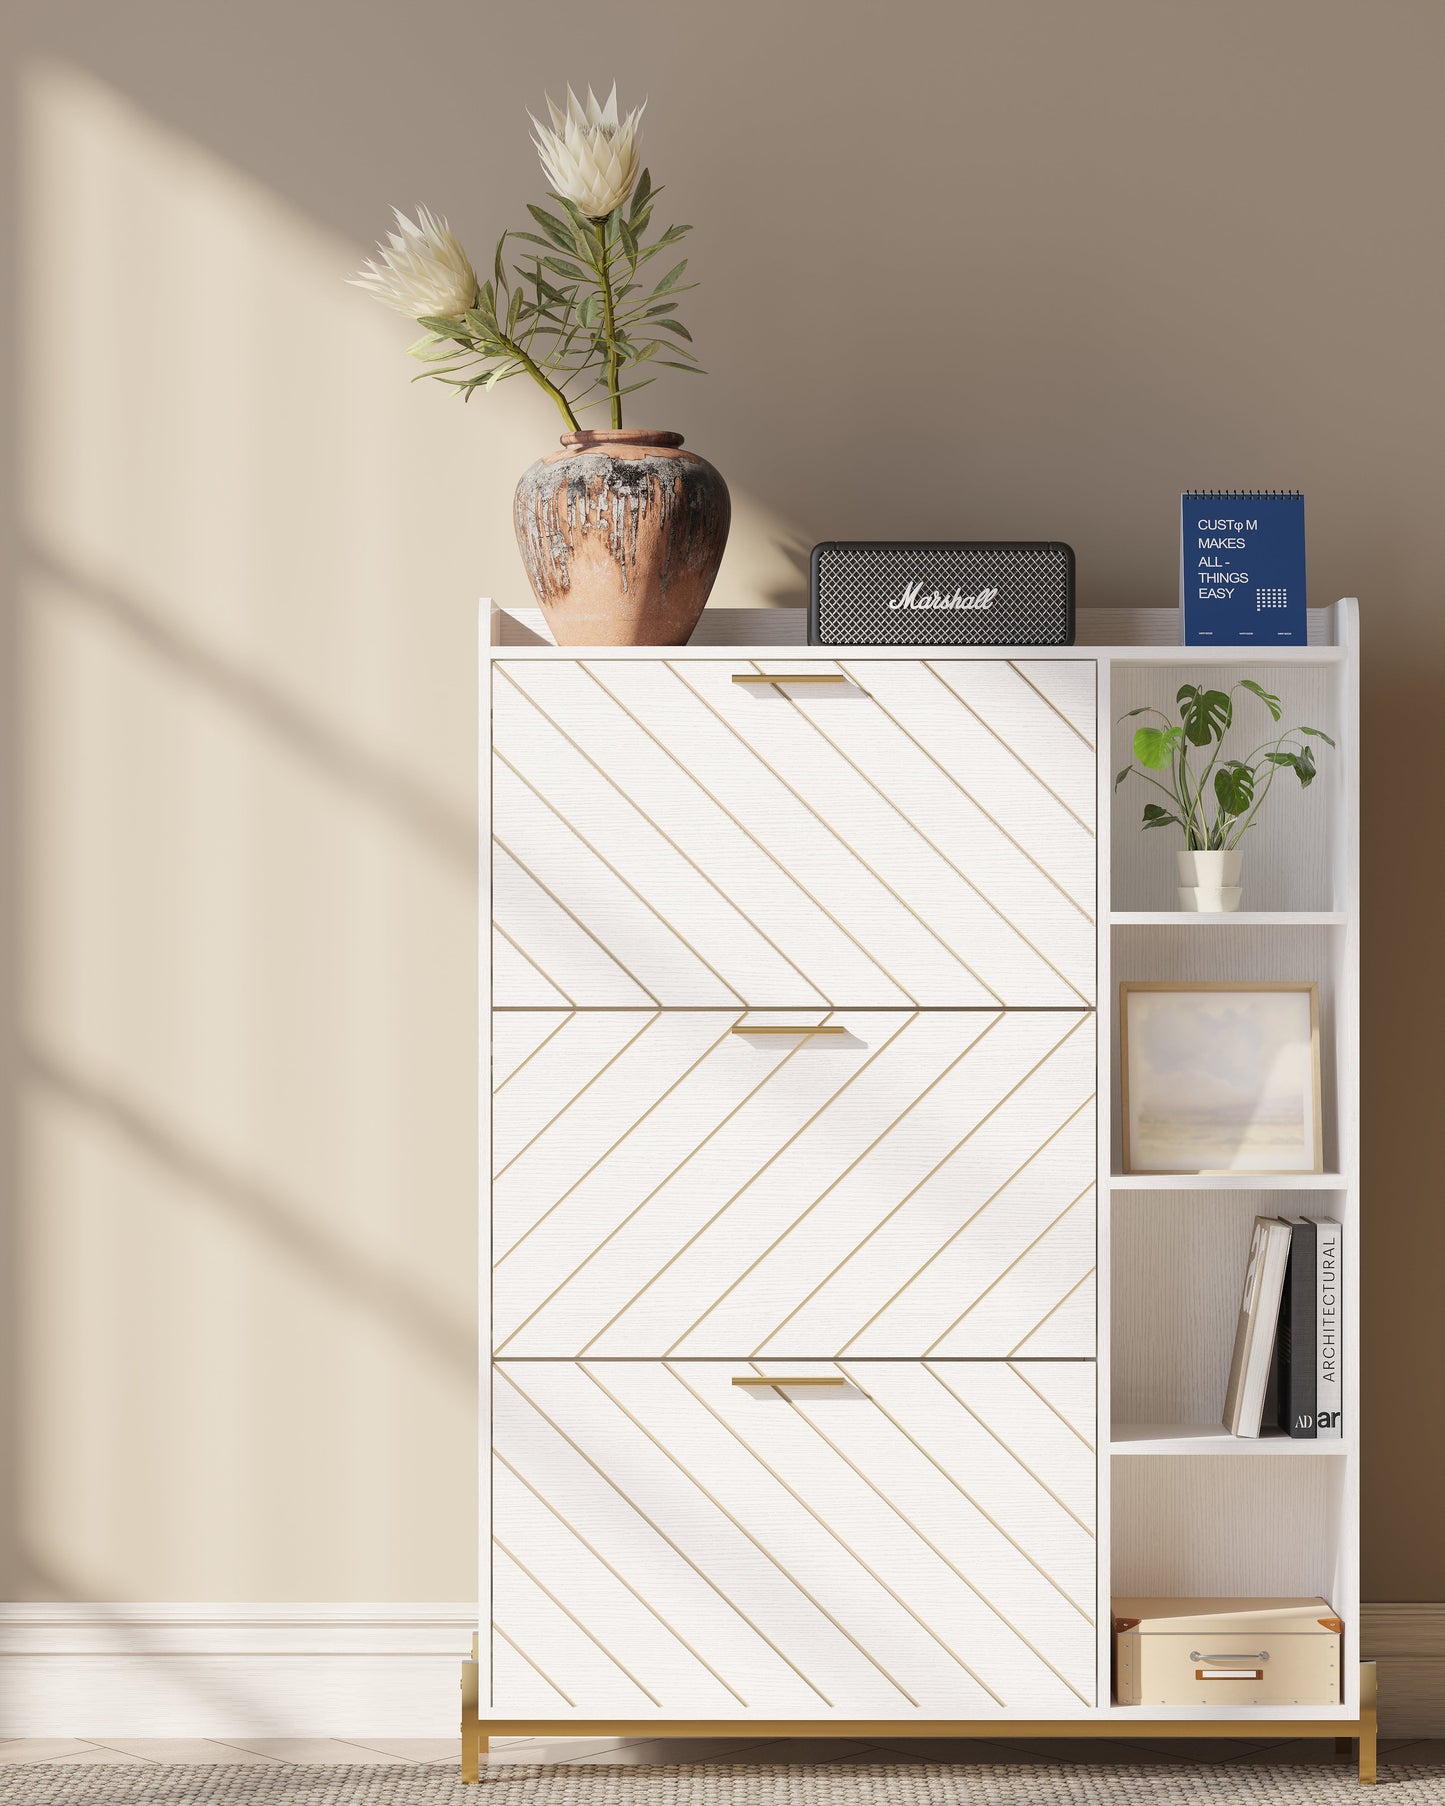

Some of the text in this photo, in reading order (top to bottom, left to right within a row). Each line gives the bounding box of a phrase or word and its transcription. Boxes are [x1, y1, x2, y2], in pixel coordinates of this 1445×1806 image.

[1198, 538, 1245, 549] MAKES
[1198, 556, 1222, 567] ALL
[1198, 572, 1248, 583] THINGS
[889, 581, 998, 610] Marshall
[1198, 588, 1235, 599] EASY
[1322, 1237, 1336, 1382] ARCHITECTURAL
[1295, 1415, 1313, 1428] AD
[1317, 1411, 1341, 1428] ar
